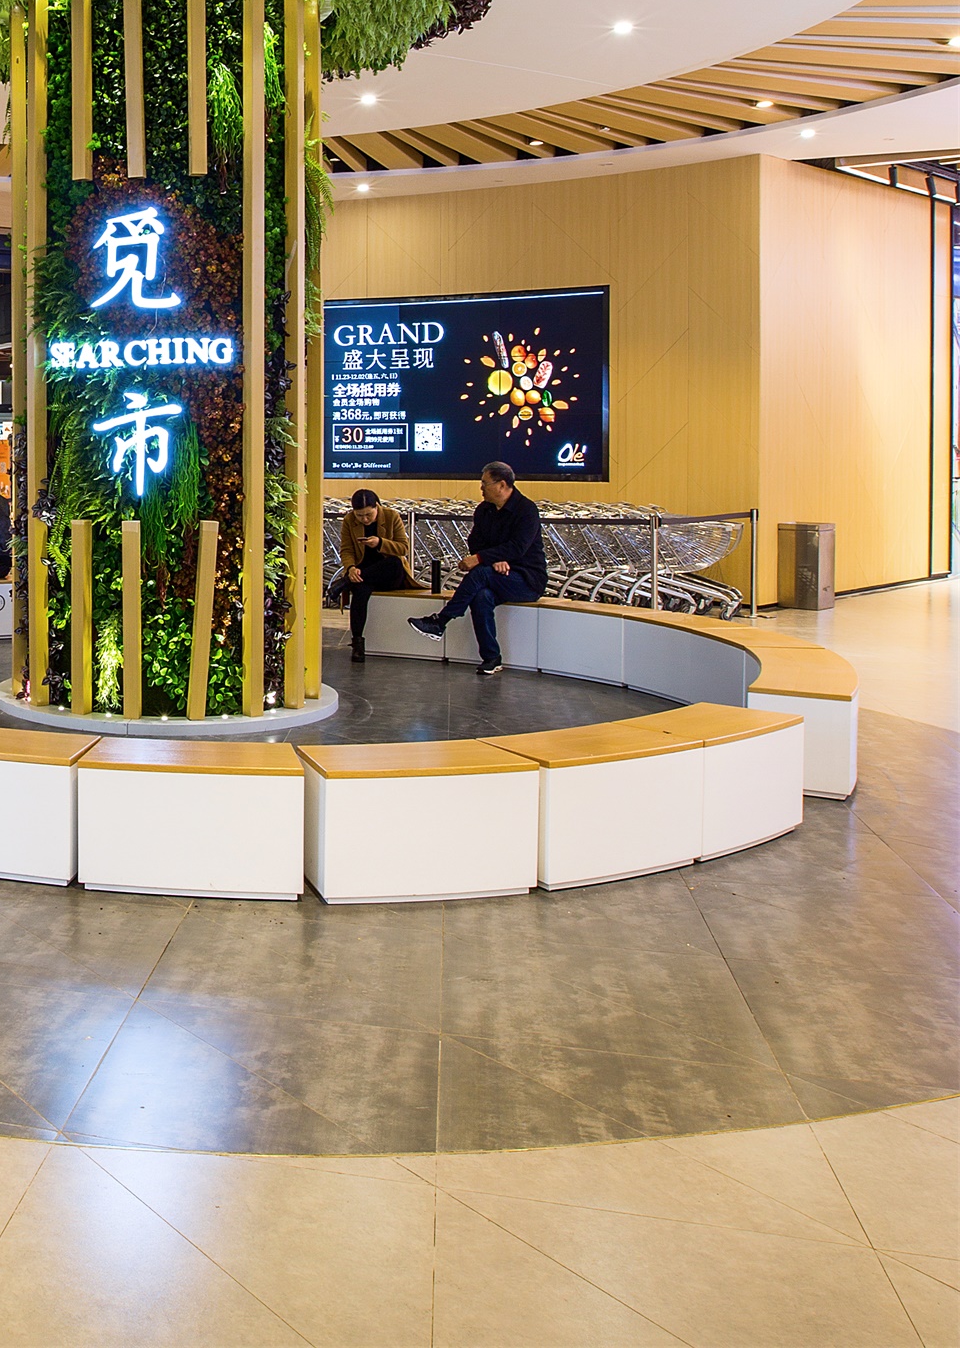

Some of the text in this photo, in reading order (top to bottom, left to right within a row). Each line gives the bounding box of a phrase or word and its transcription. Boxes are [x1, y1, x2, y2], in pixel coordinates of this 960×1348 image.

[333, 321, 445, 347] GRAND
[49, 338, 234, 369] SEARCHING
[342, 348, 435, 371] 盛大呈现
[332, 382, 402, 398] 全场抵用券
[93, 392, 183, 497] 市
